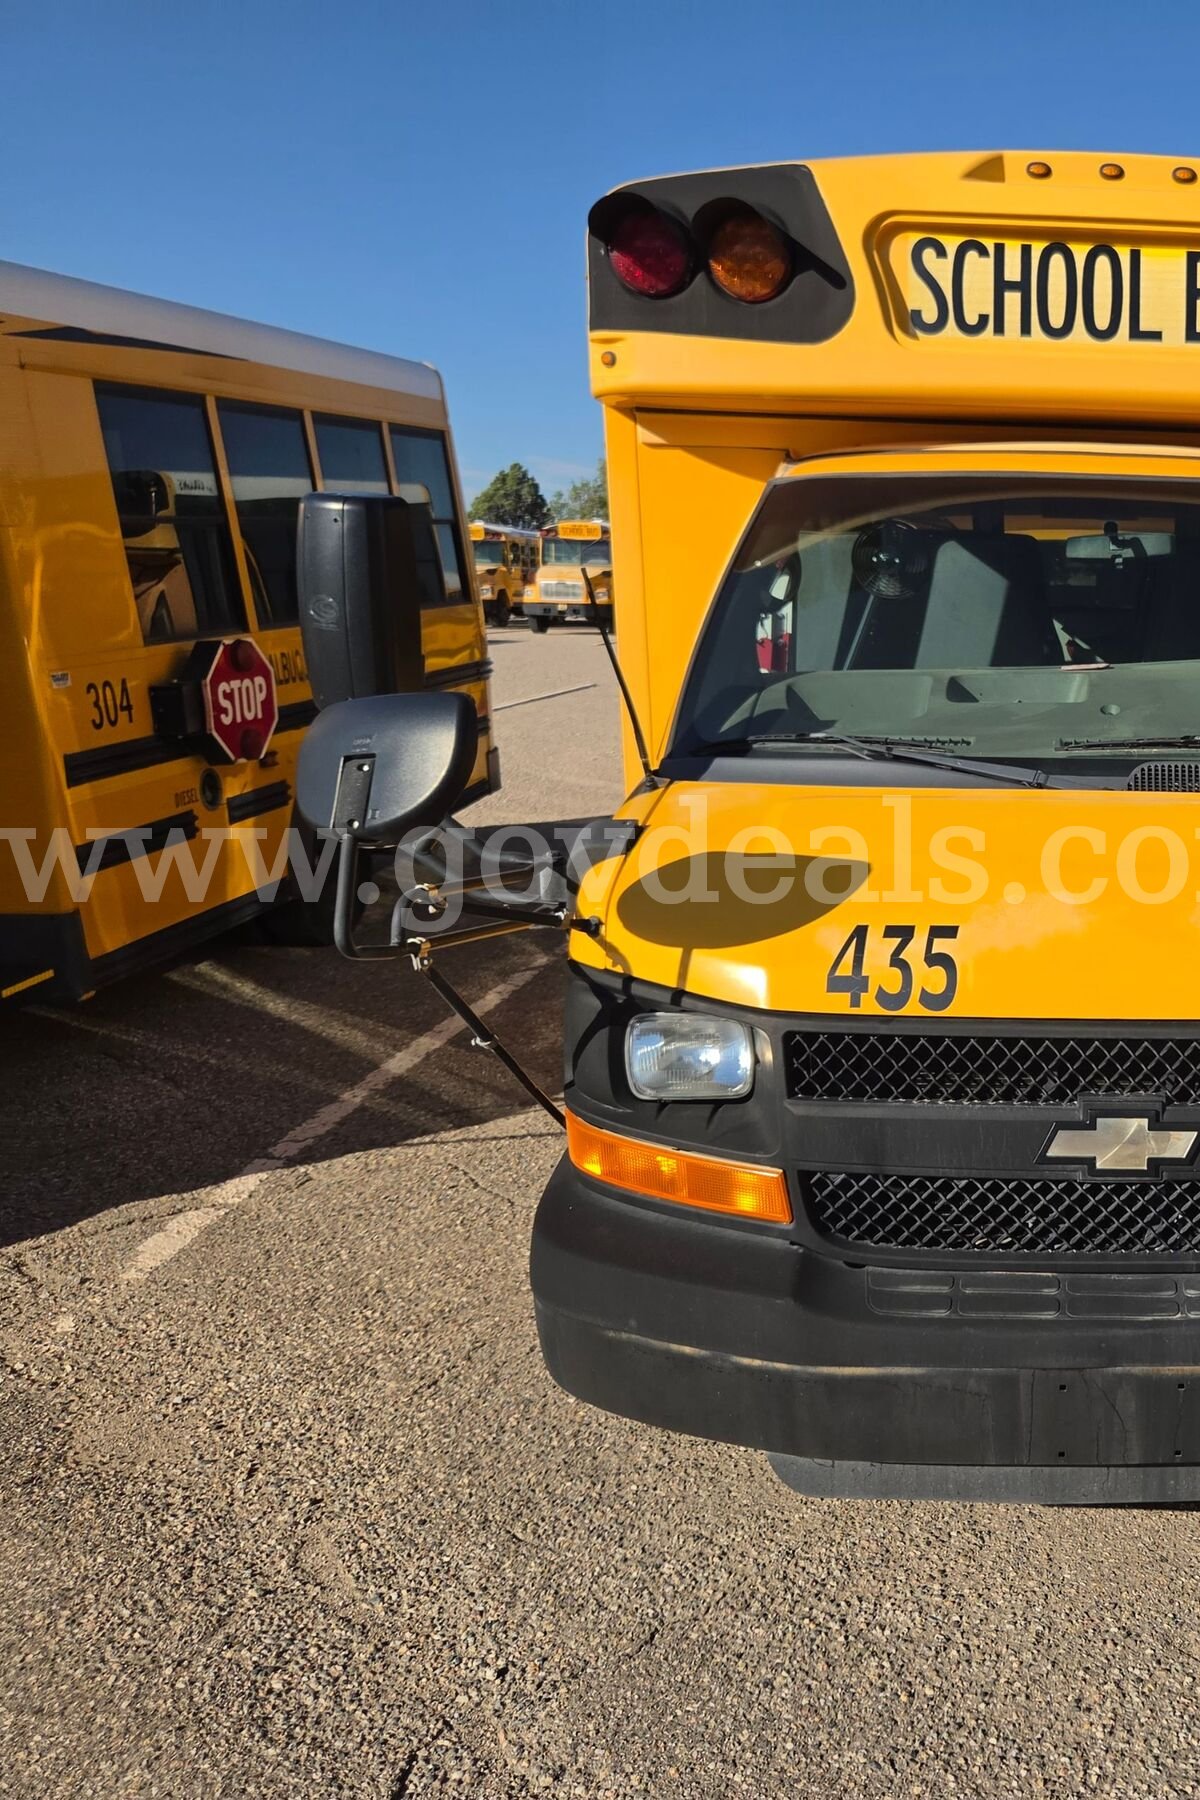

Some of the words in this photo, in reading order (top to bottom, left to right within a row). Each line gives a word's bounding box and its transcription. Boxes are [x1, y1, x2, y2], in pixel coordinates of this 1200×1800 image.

[910, 237, 1162, 341] SCHOOL
[86, 677, 134, 730] 304
[217, 676, 268, 726] STOP
[174, 787, 200, 809] DIESEL
[825, 924, 961, 1012] 435
